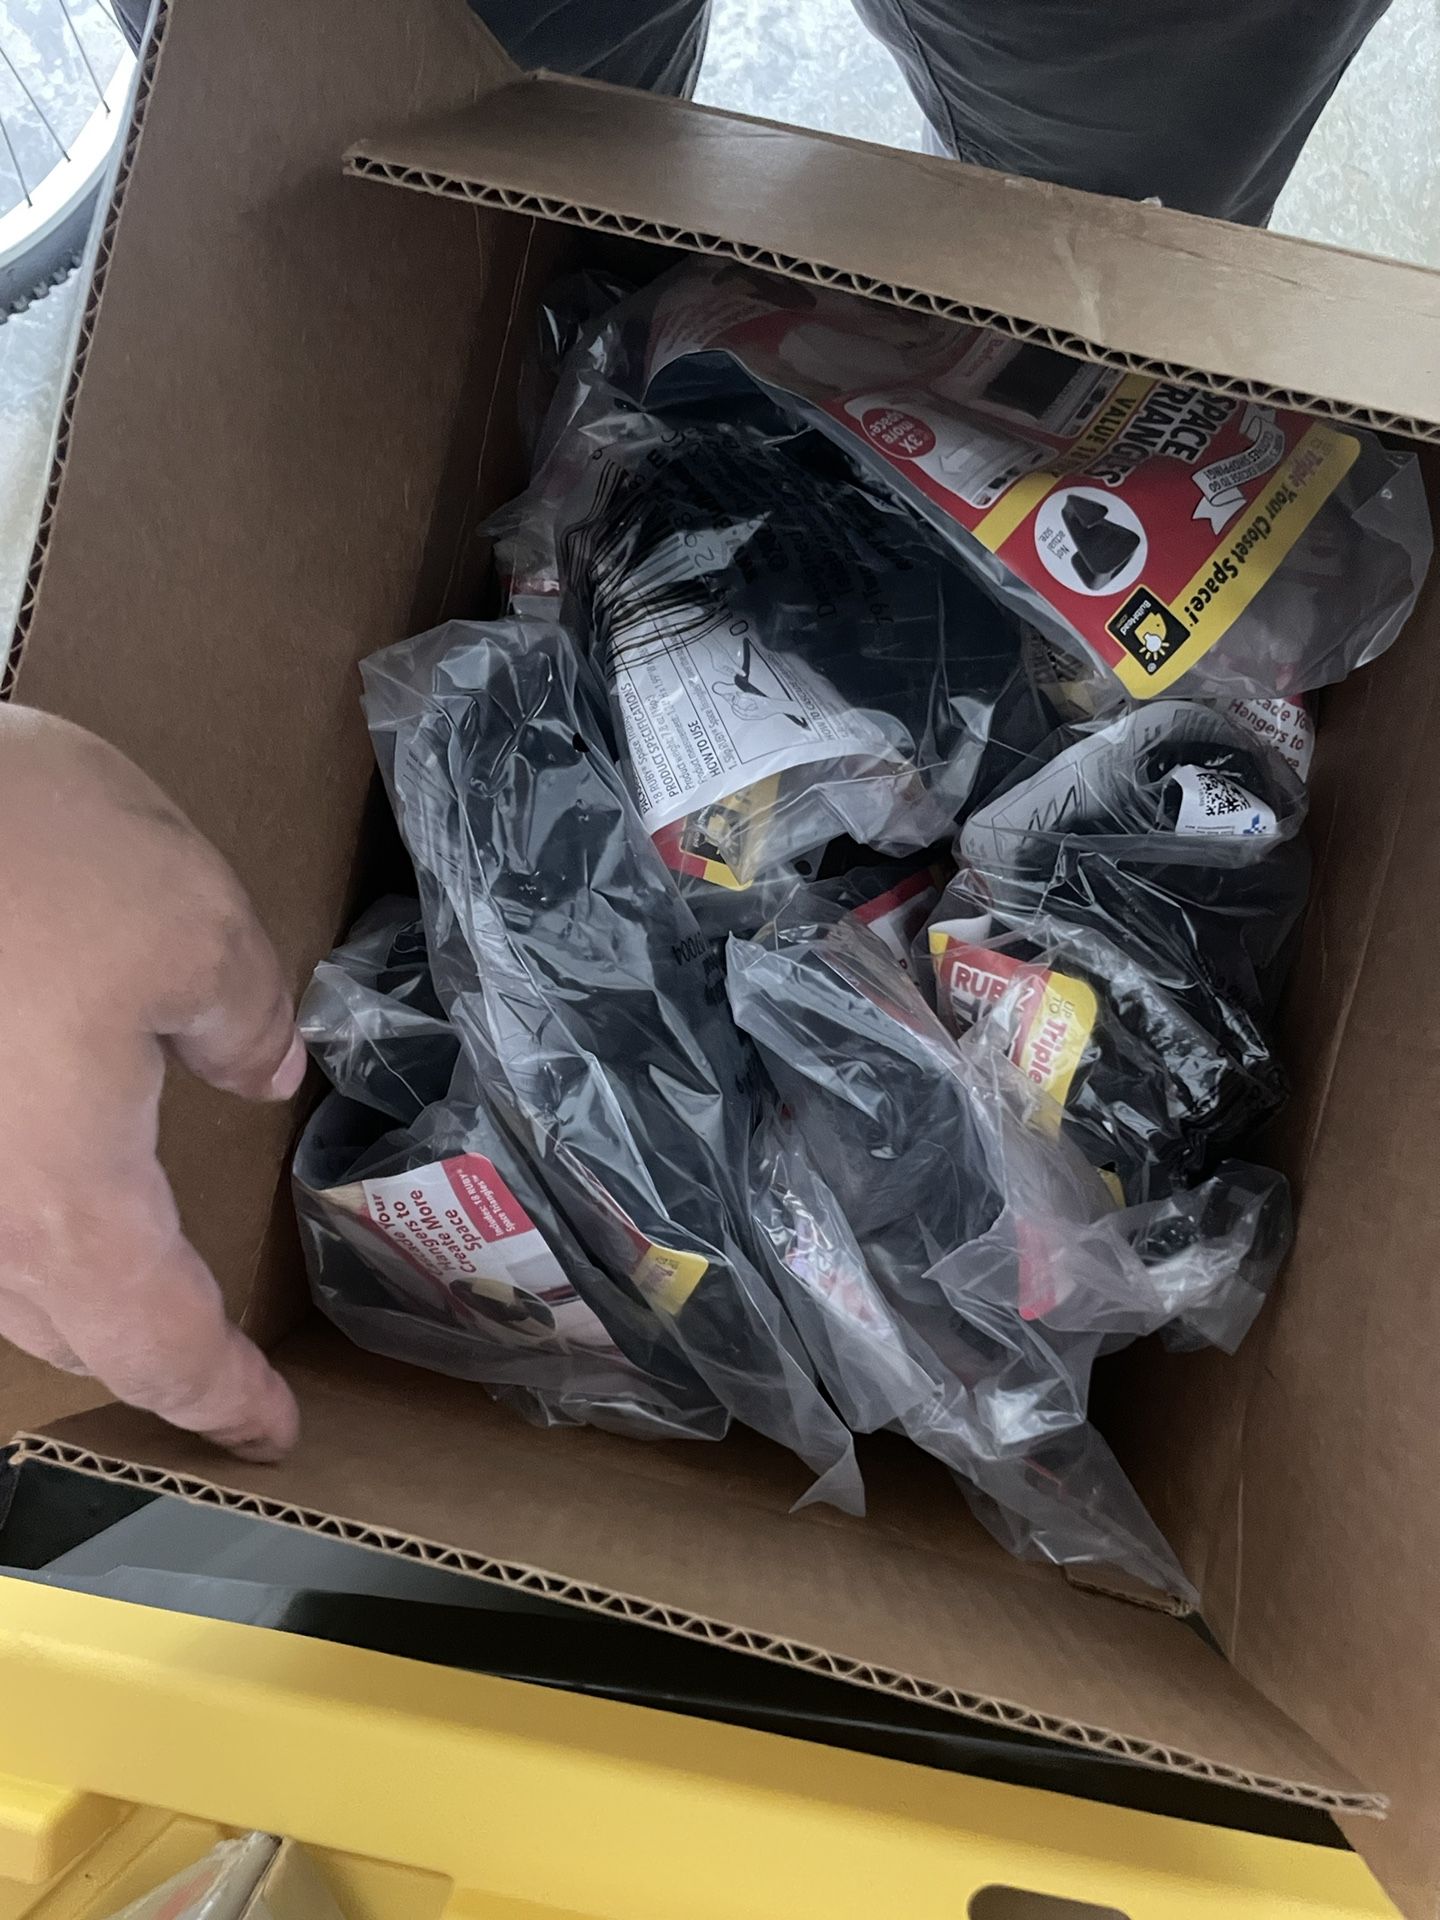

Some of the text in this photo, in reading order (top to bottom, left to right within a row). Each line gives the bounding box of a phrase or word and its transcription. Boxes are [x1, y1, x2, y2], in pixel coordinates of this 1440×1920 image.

[880, 418, 914, 445] more
[1088, 395, 1135, 445] VALUE
[1160, 389, 1234, 463] SPACE
[897, 430, 924, 456] 3X
[1208, 480, 1221, 493] GO
[1260, 482, 1297, 522] Your
[1037, 526, 1054, 543] size.
[1046, 530, 1066, 552] actual
[1228, 514, 1274, 564] Closet
[1054, 544, 1070, 560] Not
[1118, 599, 1152, 636] BulbHead
[700, 707, 719, 729] Space
[810, 709, 821, 722] TO
[1229, 701, 1304, 750] Hangers to
[619, 681, 679, 798] PRODUCT SPECIFICATIONS
[818, 721, 835, 742] HOW
[630, 738, 649, 764] Space
[686, 719, 720, 777] HOW TO USE
[673, 760, 695, 791] Product
[686, 756, 707, 785] Product
[652, 791, 664, 803] 18
[954, 963, 1008, 1003] RUB
[1049, 997, 1062, 1015] TO
[1062, 1000, 1076, 1018] UP
[1028, 1019, 1068, 1084] Triple
[470, 1193, 483, 1205] 18
[370, 1192, 442, 1276] Cascade Your
[390, 1199, 454, 1271] Hangers to
[409, 1189, 475, 1272] Create More
[445, 1208, 481, 1252] Space
[477, 1204, 503, 1237] Includes:
[495, 1210, 516, 1234] Space
